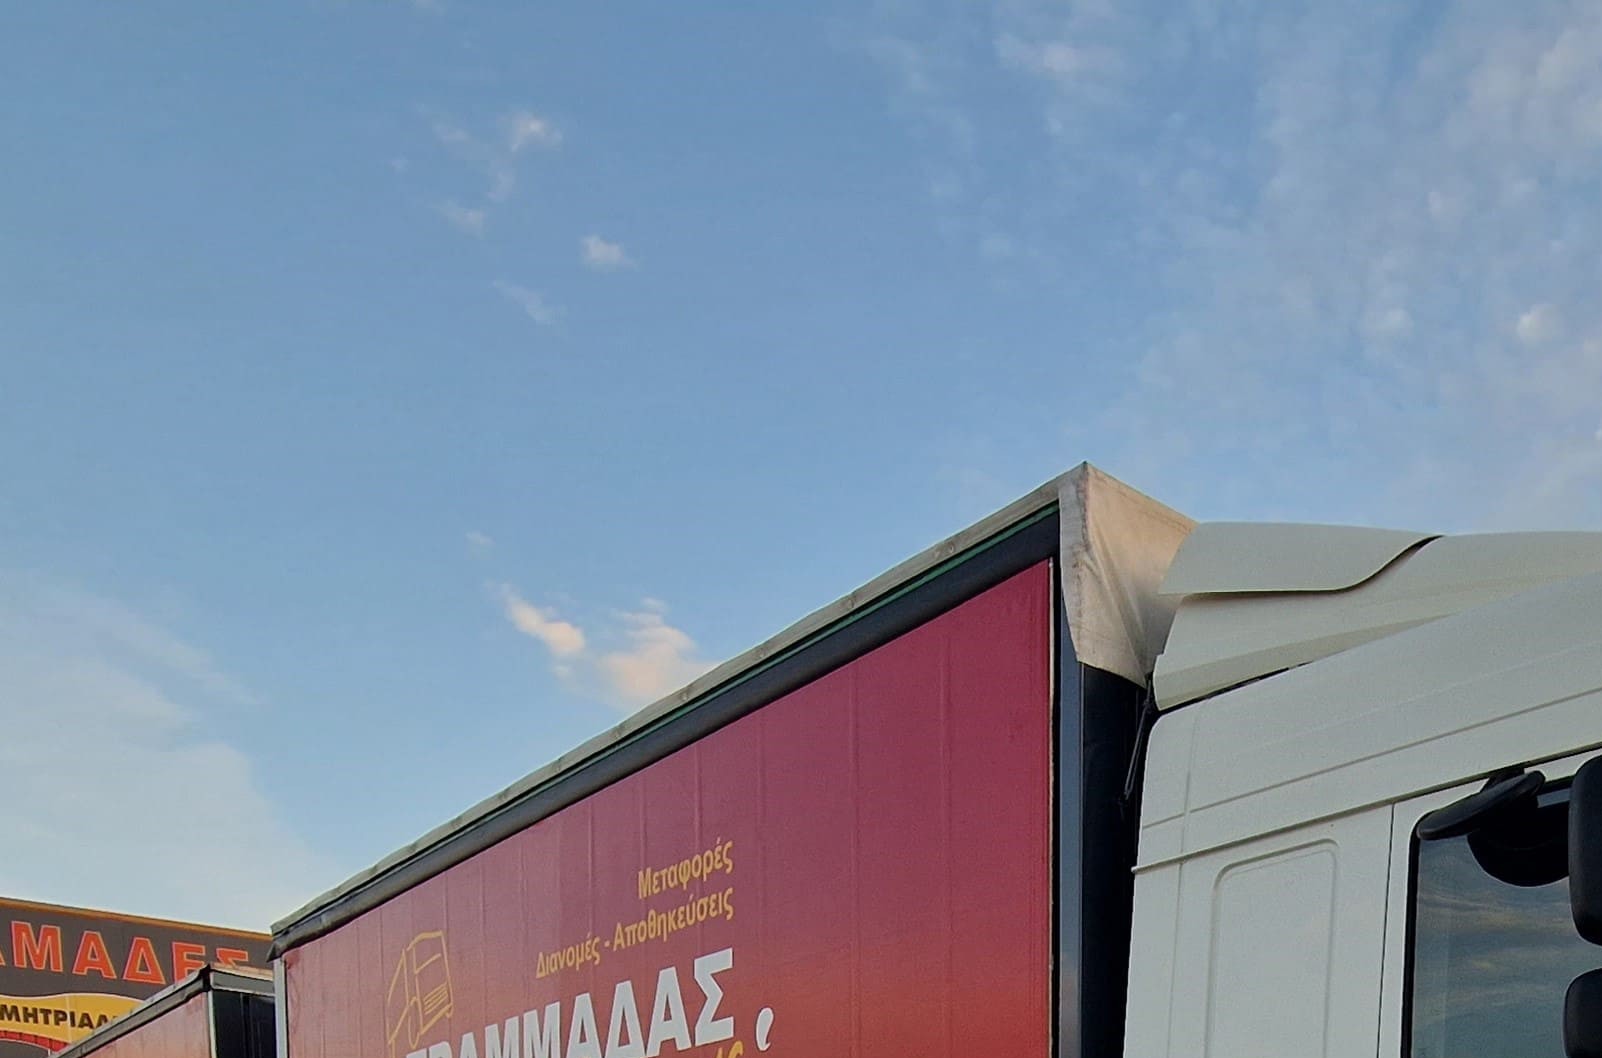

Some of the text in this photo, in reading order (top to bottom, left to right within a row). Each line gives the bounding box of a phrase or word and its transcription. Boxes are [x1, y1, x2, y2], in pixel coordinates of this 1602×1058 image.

[638, 837, 733, 899] Μεταφορές
[0, 920, 249, 985] ΜΑΔΕ
[536, 932, 600, 979] Διανομές
[612, 888, 733, 951] Αποθηκεύσεις
